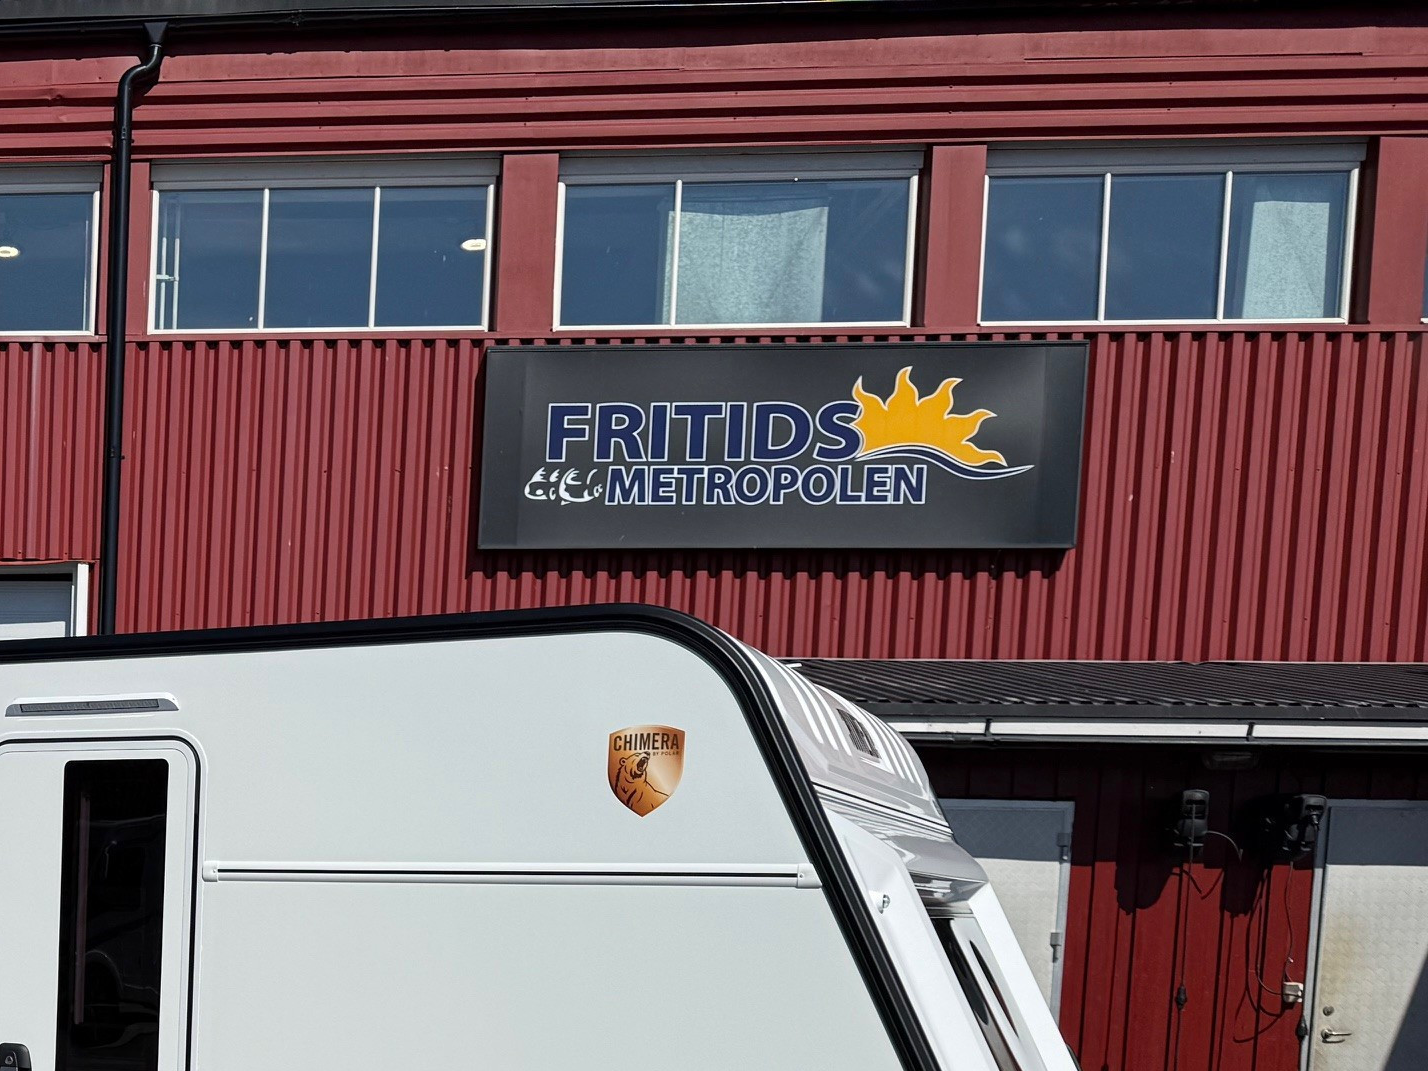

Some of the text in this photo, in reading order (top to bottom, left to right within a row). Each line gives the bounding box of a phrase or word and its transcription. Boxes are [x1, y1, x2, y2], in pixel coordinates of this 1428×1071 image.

[545, 400, 865, 463] FRITIDS
[604, 465, 927, 505] METROPOLEN
[613, 733, 679, 751] CHIMERA
